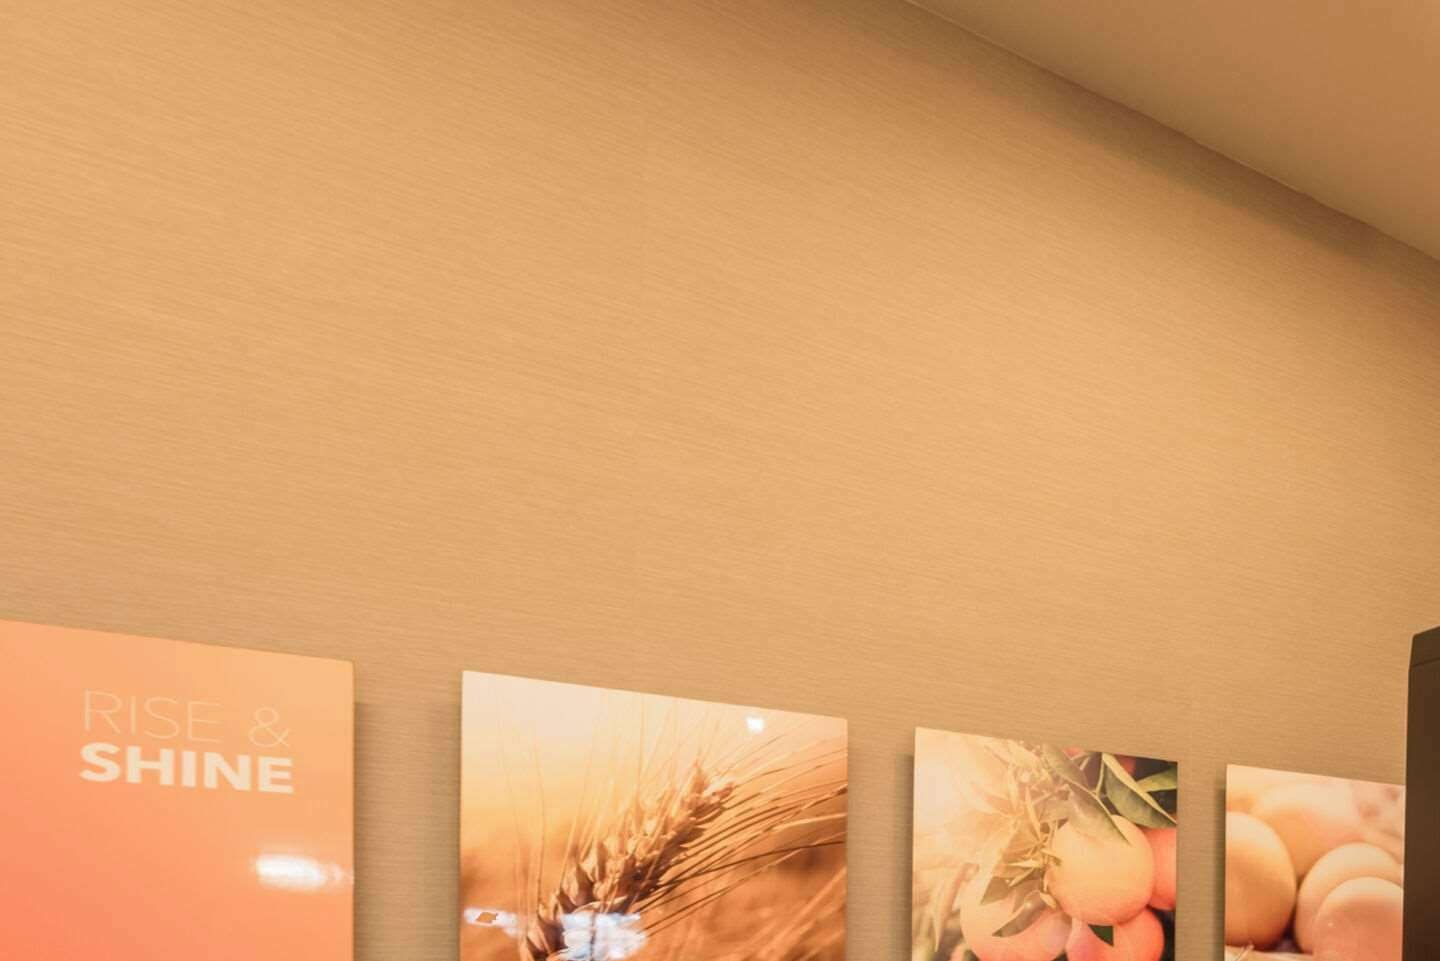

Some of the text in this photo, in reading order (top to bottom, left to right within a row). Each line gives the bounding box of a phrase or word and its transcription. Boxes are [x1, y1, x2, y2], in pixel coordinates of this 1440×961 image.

[84, 688, 291, 749] RISE &
[79, 741, 295, 794] SHINE
